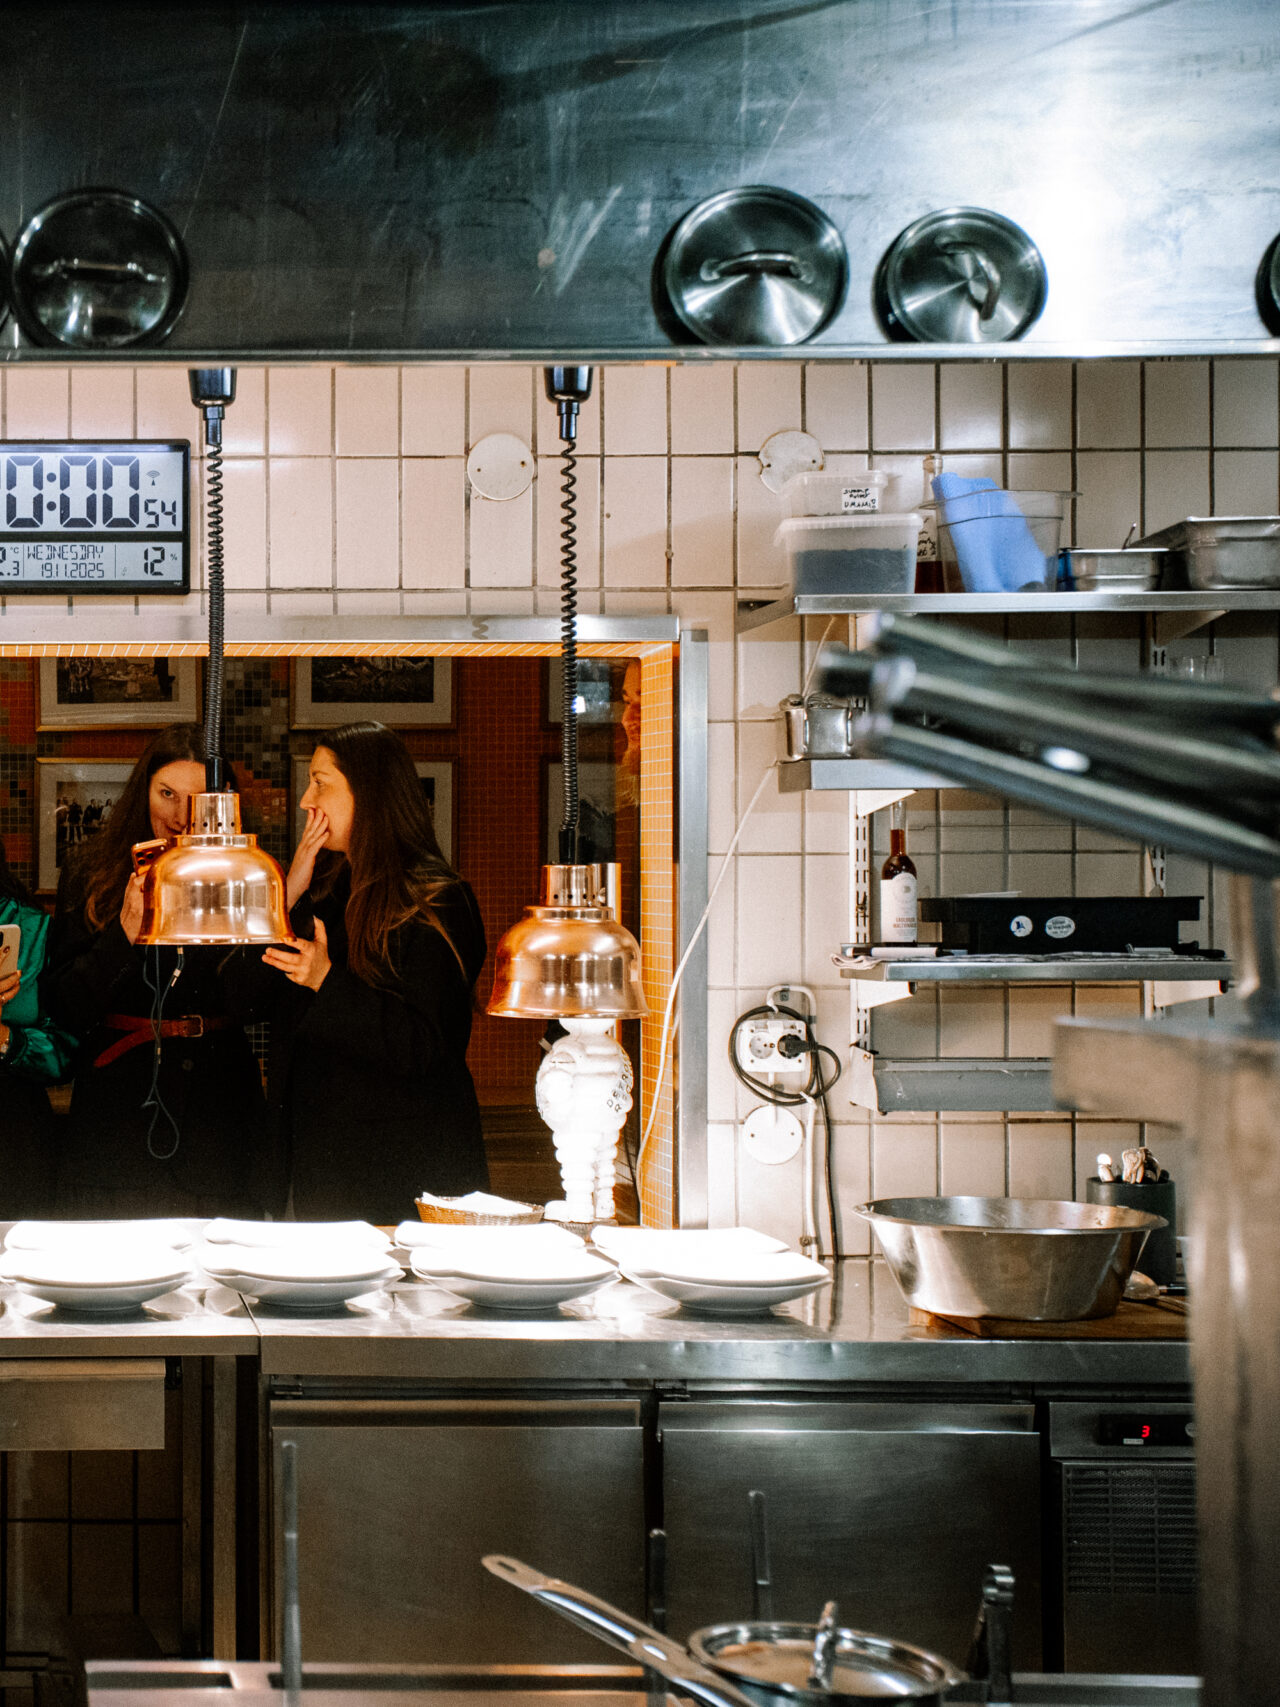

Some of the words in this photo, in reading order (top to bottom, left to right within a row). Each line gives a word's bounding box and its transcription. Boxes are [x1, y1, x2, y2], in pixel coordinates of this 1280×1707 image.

[144, 499, 177, 528] 54
[27, 546, 104, 560] WEDNESDAY
[143, 547, 166, 576] 12
[41, 563, 105, 578] 19.11.2025
[1141, 1425, 1151, 1438] 3
